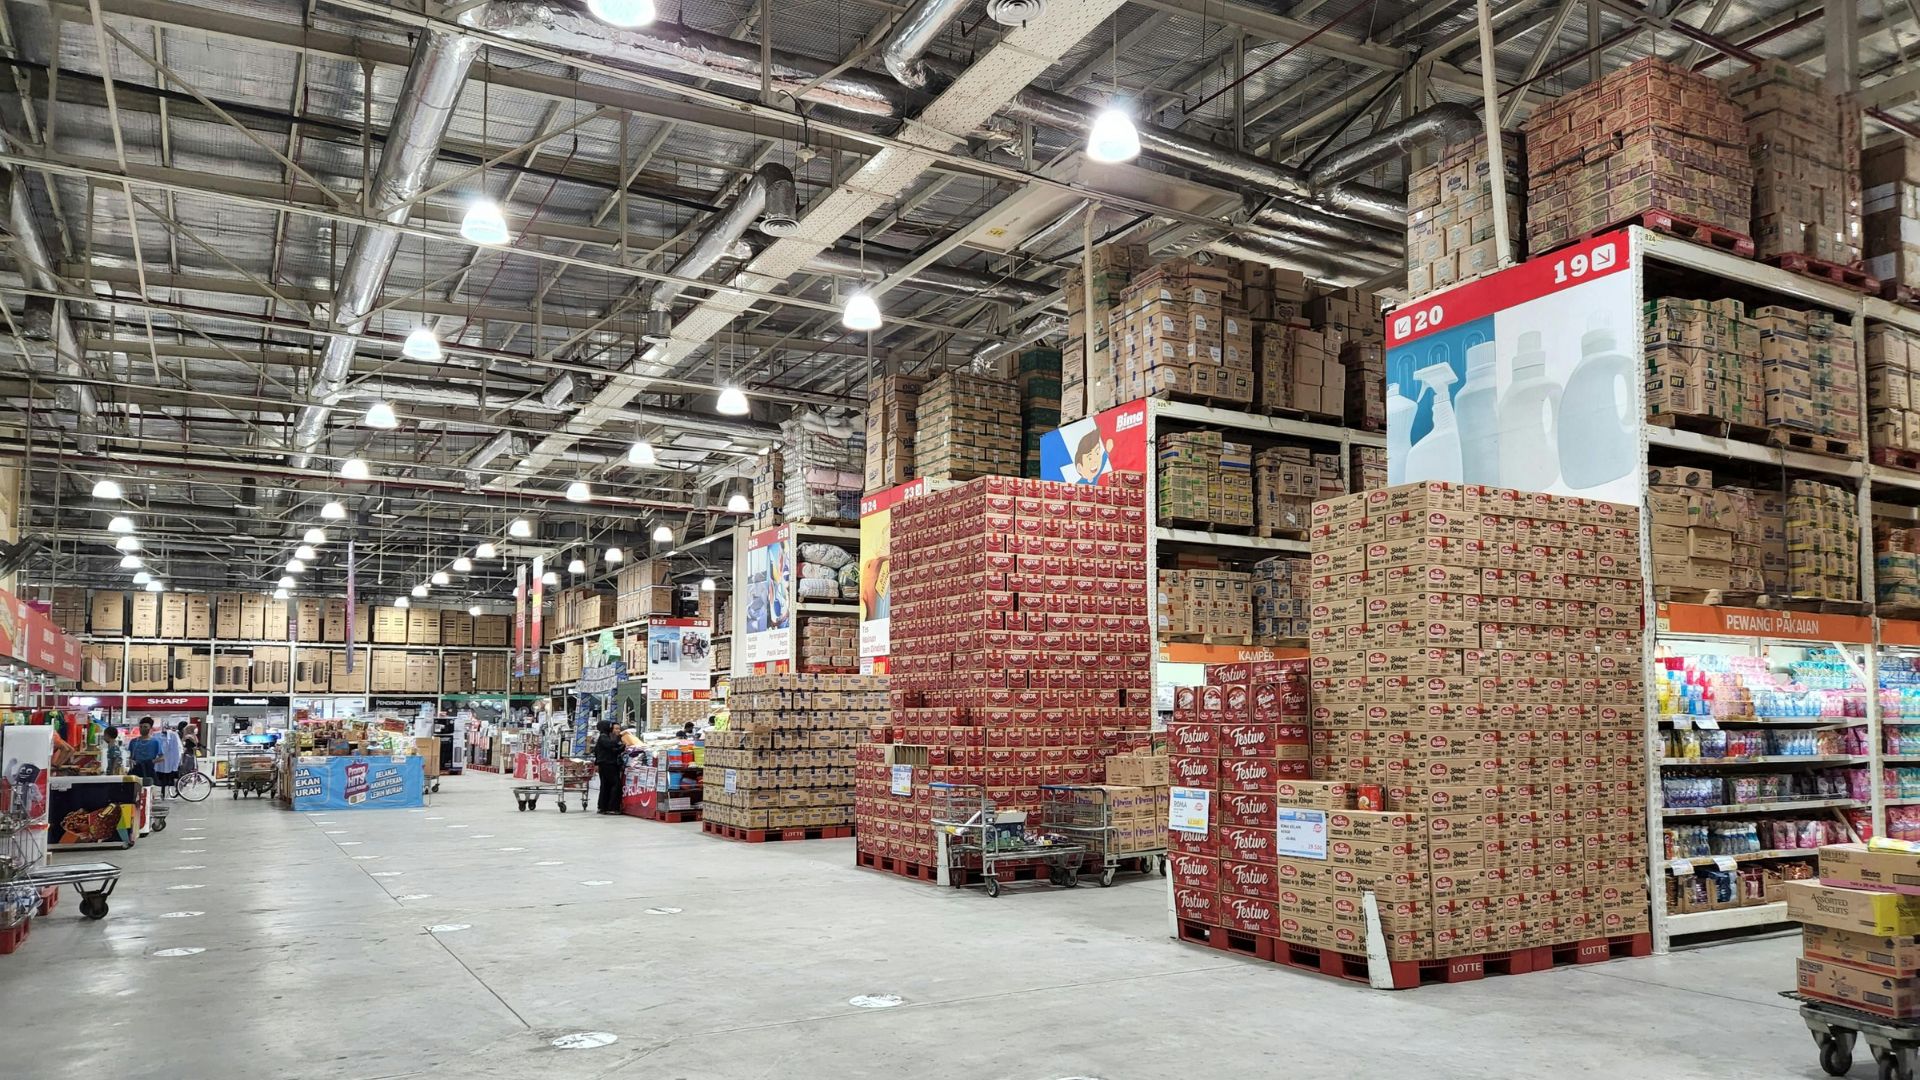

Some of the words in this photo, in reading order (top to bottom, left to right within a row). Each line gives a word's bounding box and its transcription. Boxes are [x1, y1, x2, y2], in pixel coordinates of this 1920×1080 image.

[1554, 254, 1588, 284] 19
[1414, 305, 1444, 332] 20
[1668, 330, 1680, 338] HIT
[1646, 381, 1660, 390] HIT
[1672, 377, 1682, 386] HIT
[1116, 411, 1144, 428] Bima
[904, 487, 914, 499] 23
[867, 500, 877, 512] 24
[1726, 614, 1774, 632] PEWANGI
[1776, 619, 1819, 635] PAKAIAN
[1238, 650, 1275, 661] KAMPER
[1214, 665, 1247, 683] Festive
[1176, 725, 1209, 745] Festive
[1230, 726, 1266, 747] Festive
[1185, 745, 1201, 754] Treats
[1240, 747, 1257, 756] Treats
[376, 768, 397, 778] BELANJA
[1177, 758, 1208, 777] Festive
[1231, 760, 1267, 781] Festive
[348, 774, 366, 786] HITS
[1186, 778, 1200, 786] Treats
[1242, 781, 1259, 791] Treats
[1231, 795, 1268, 815] Festive
[1242, 815, 1259, 825] Treats
[1230, 829, 1267, 849] Festive
[1186, 843, 1200, 853] Treats
[1241, 850, 1258, 860] Treats
[1176, 856, 1208, 875] Festive
[1232, 864, 1268, 885] Festive
[1861, 868, 1880, 878] Rinso
[1185, 876, 1200, 886] Treats
[1242, 885, 1259, 896] Treats
[1177, 889, 1210, 909] Festive
[1811, 894, 1848, 907] ASSORTED
[1187, 909, 1202, 919] Treats
[1231, 899, 1270, 920] Festive
[1817, 902, 1849, 915] BISCUITS
[1243, 920, 1260, 931] Treats
[1581, 944, 1608, 956] LOTTE
[1452, 962, 1482, 974] LOTTE
